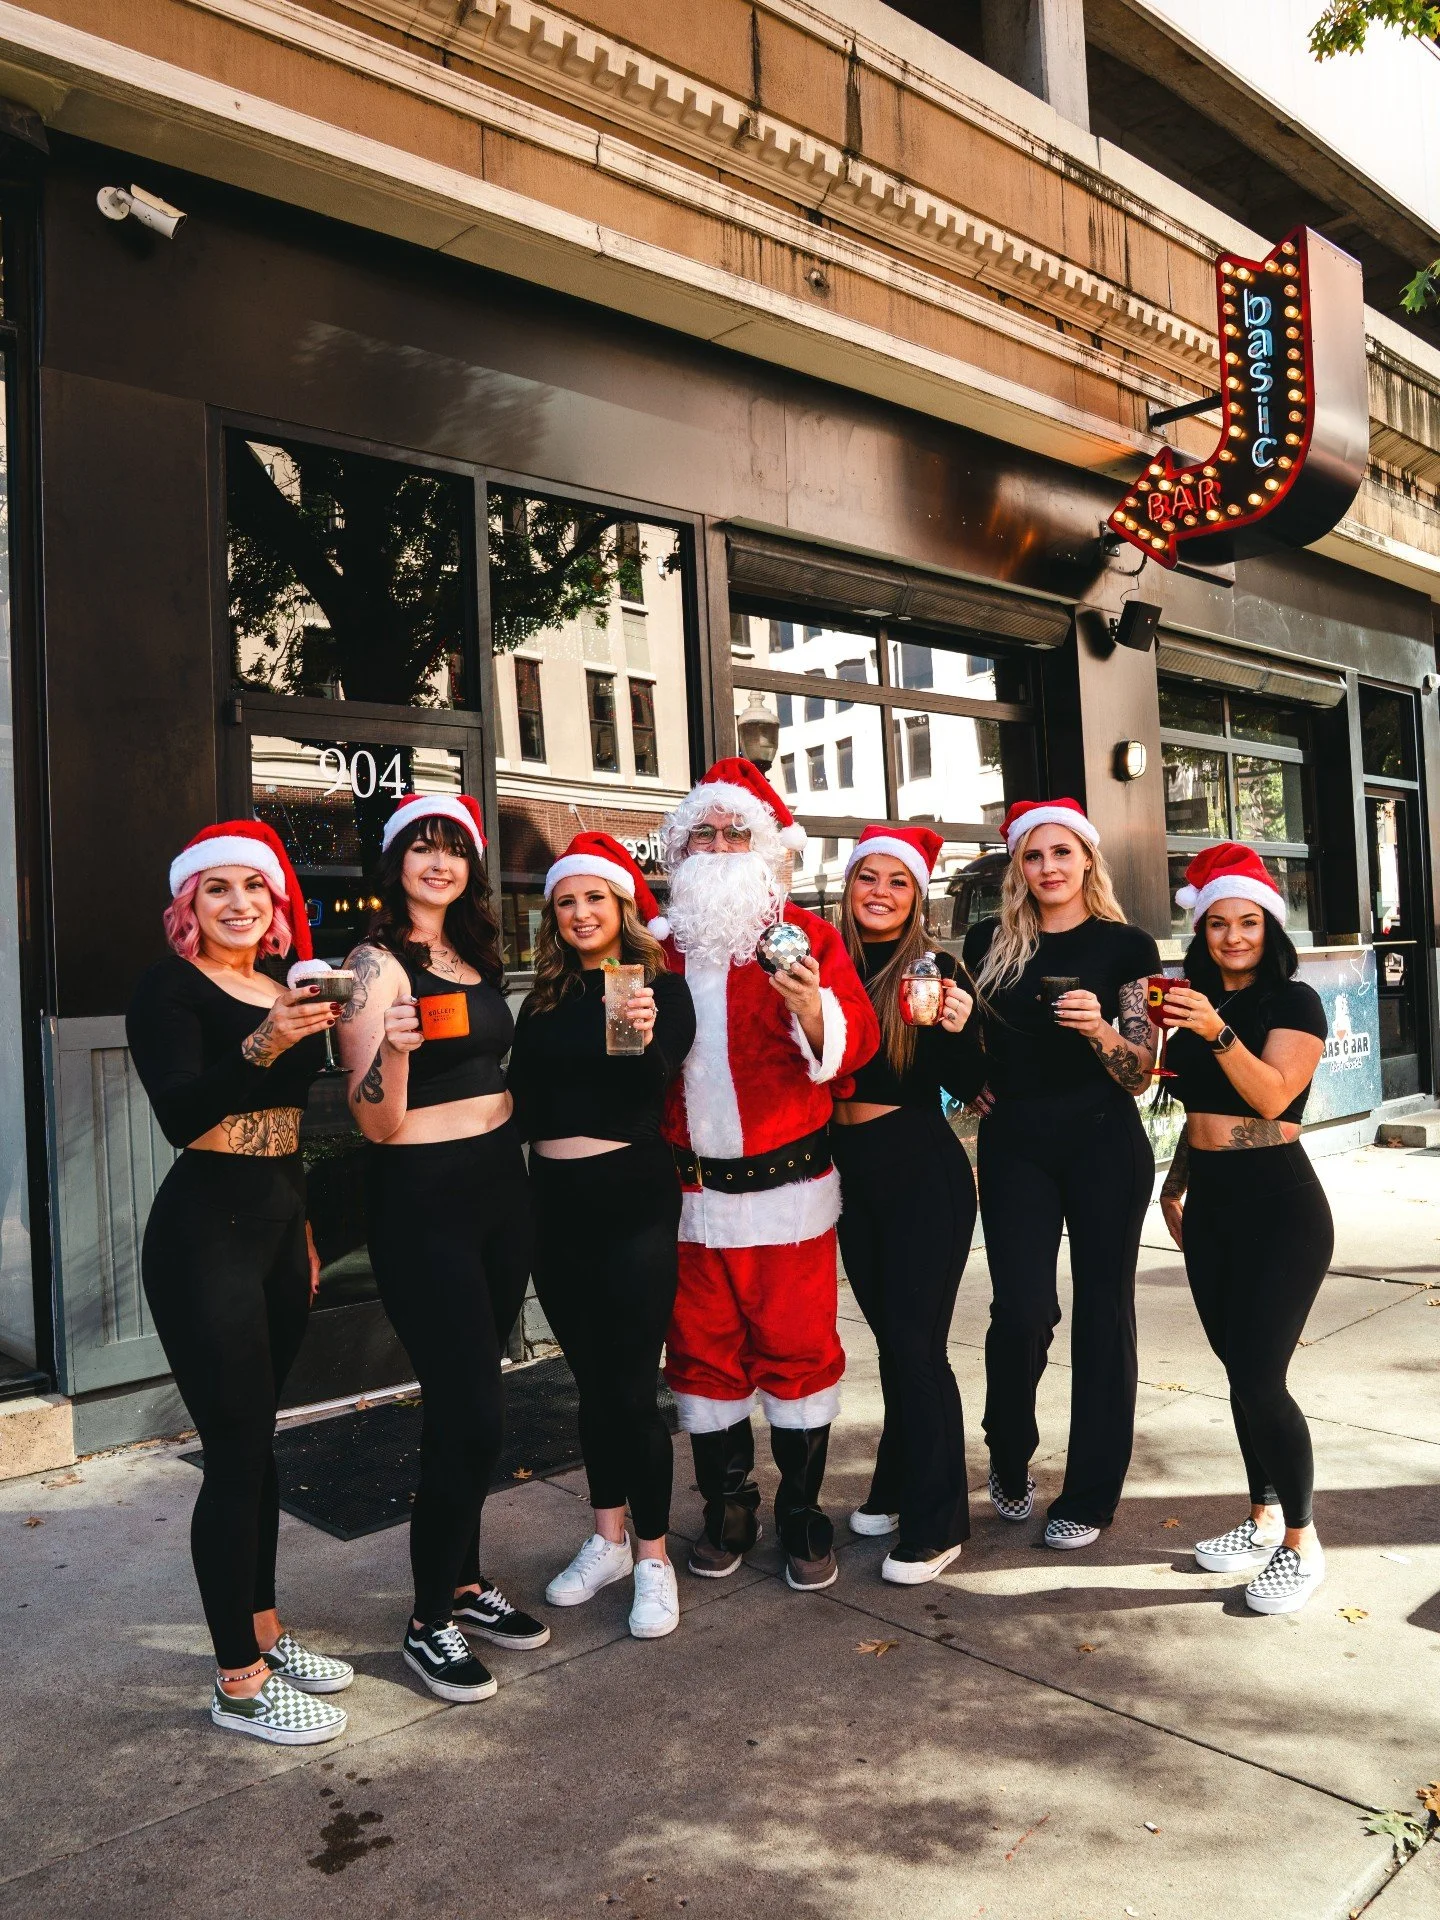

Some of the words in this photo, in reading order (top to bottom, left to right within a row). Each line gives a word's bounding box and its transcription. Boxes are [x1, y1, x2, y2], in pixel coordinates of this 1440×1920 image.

[1243, 288, 1276, 469] basic
[1148, 478, 1219, 522] BAR
[319, 748, 407, 799] 904
[1351, 1037, 1369, 1054] BAR
